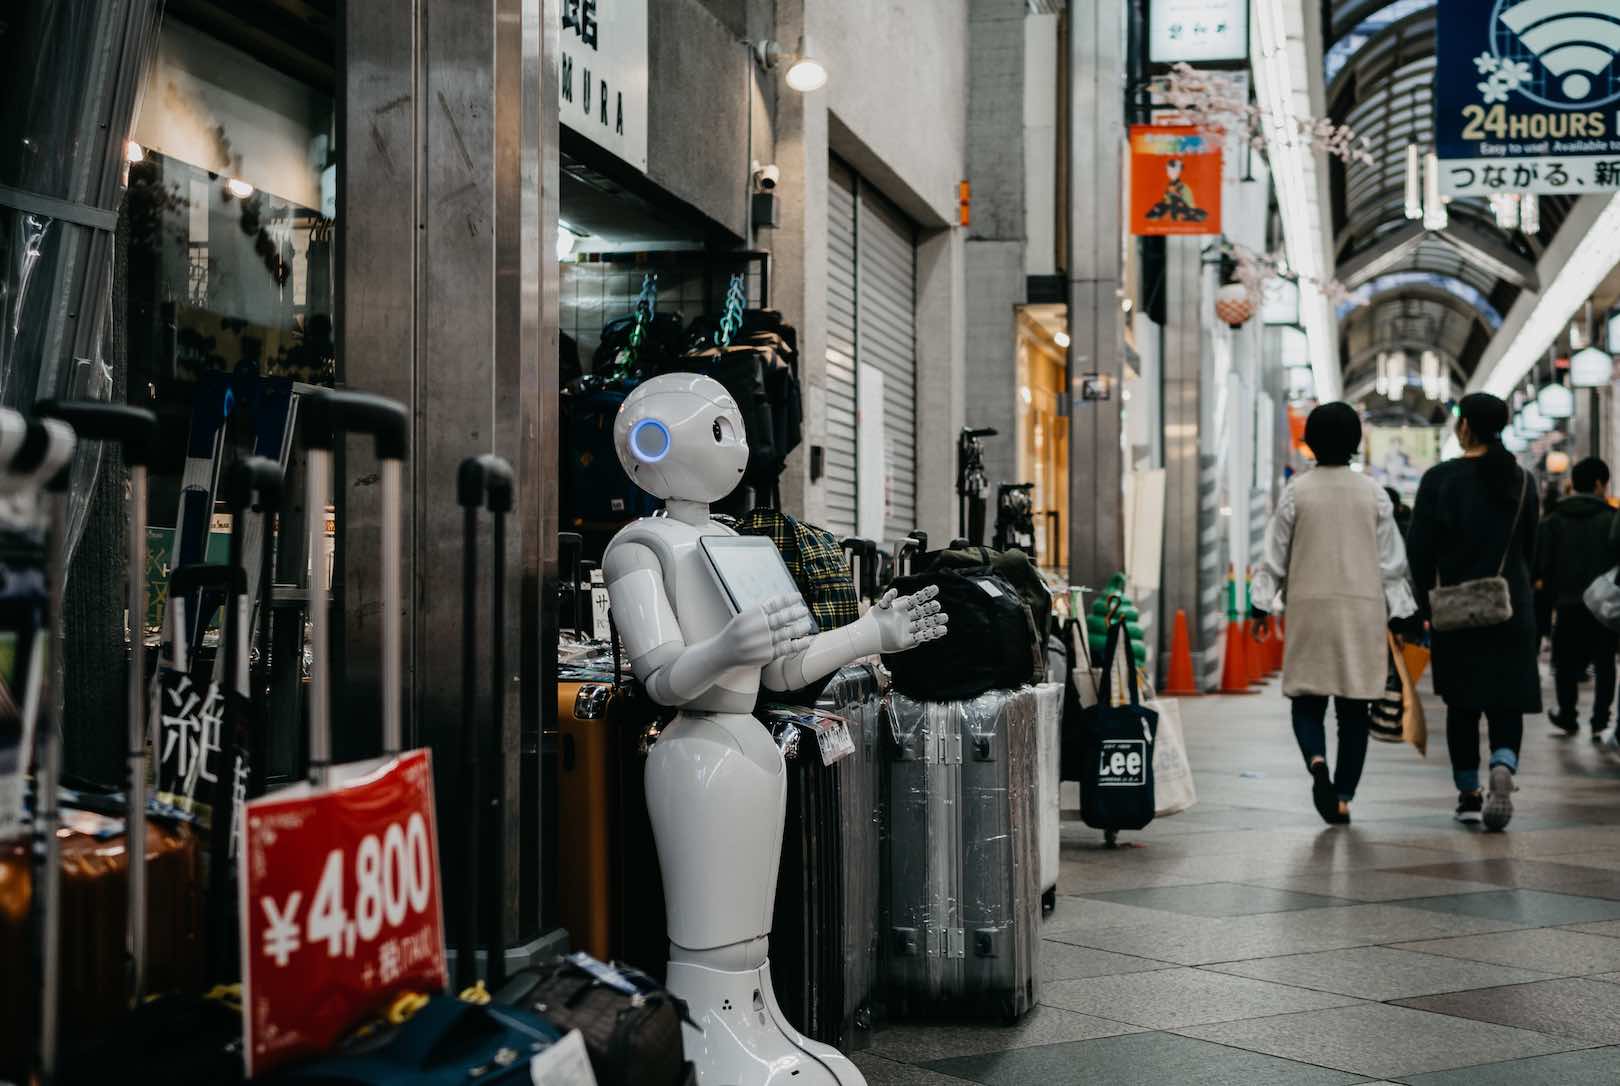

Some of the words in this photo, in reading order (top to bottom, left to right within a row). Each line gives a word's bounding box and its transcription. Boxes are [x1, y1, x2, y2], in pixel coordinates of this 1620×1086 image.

[562, 51, 623, 136] MURA
[1461, 103, 1606, 140] 24HOURS
[1480, 142, 1507, 156] Easy
[1509, 143, 1522, 154] to
[1553, 138, 1608, 153] Available
[1099, 752, 1141, 776] Lee
